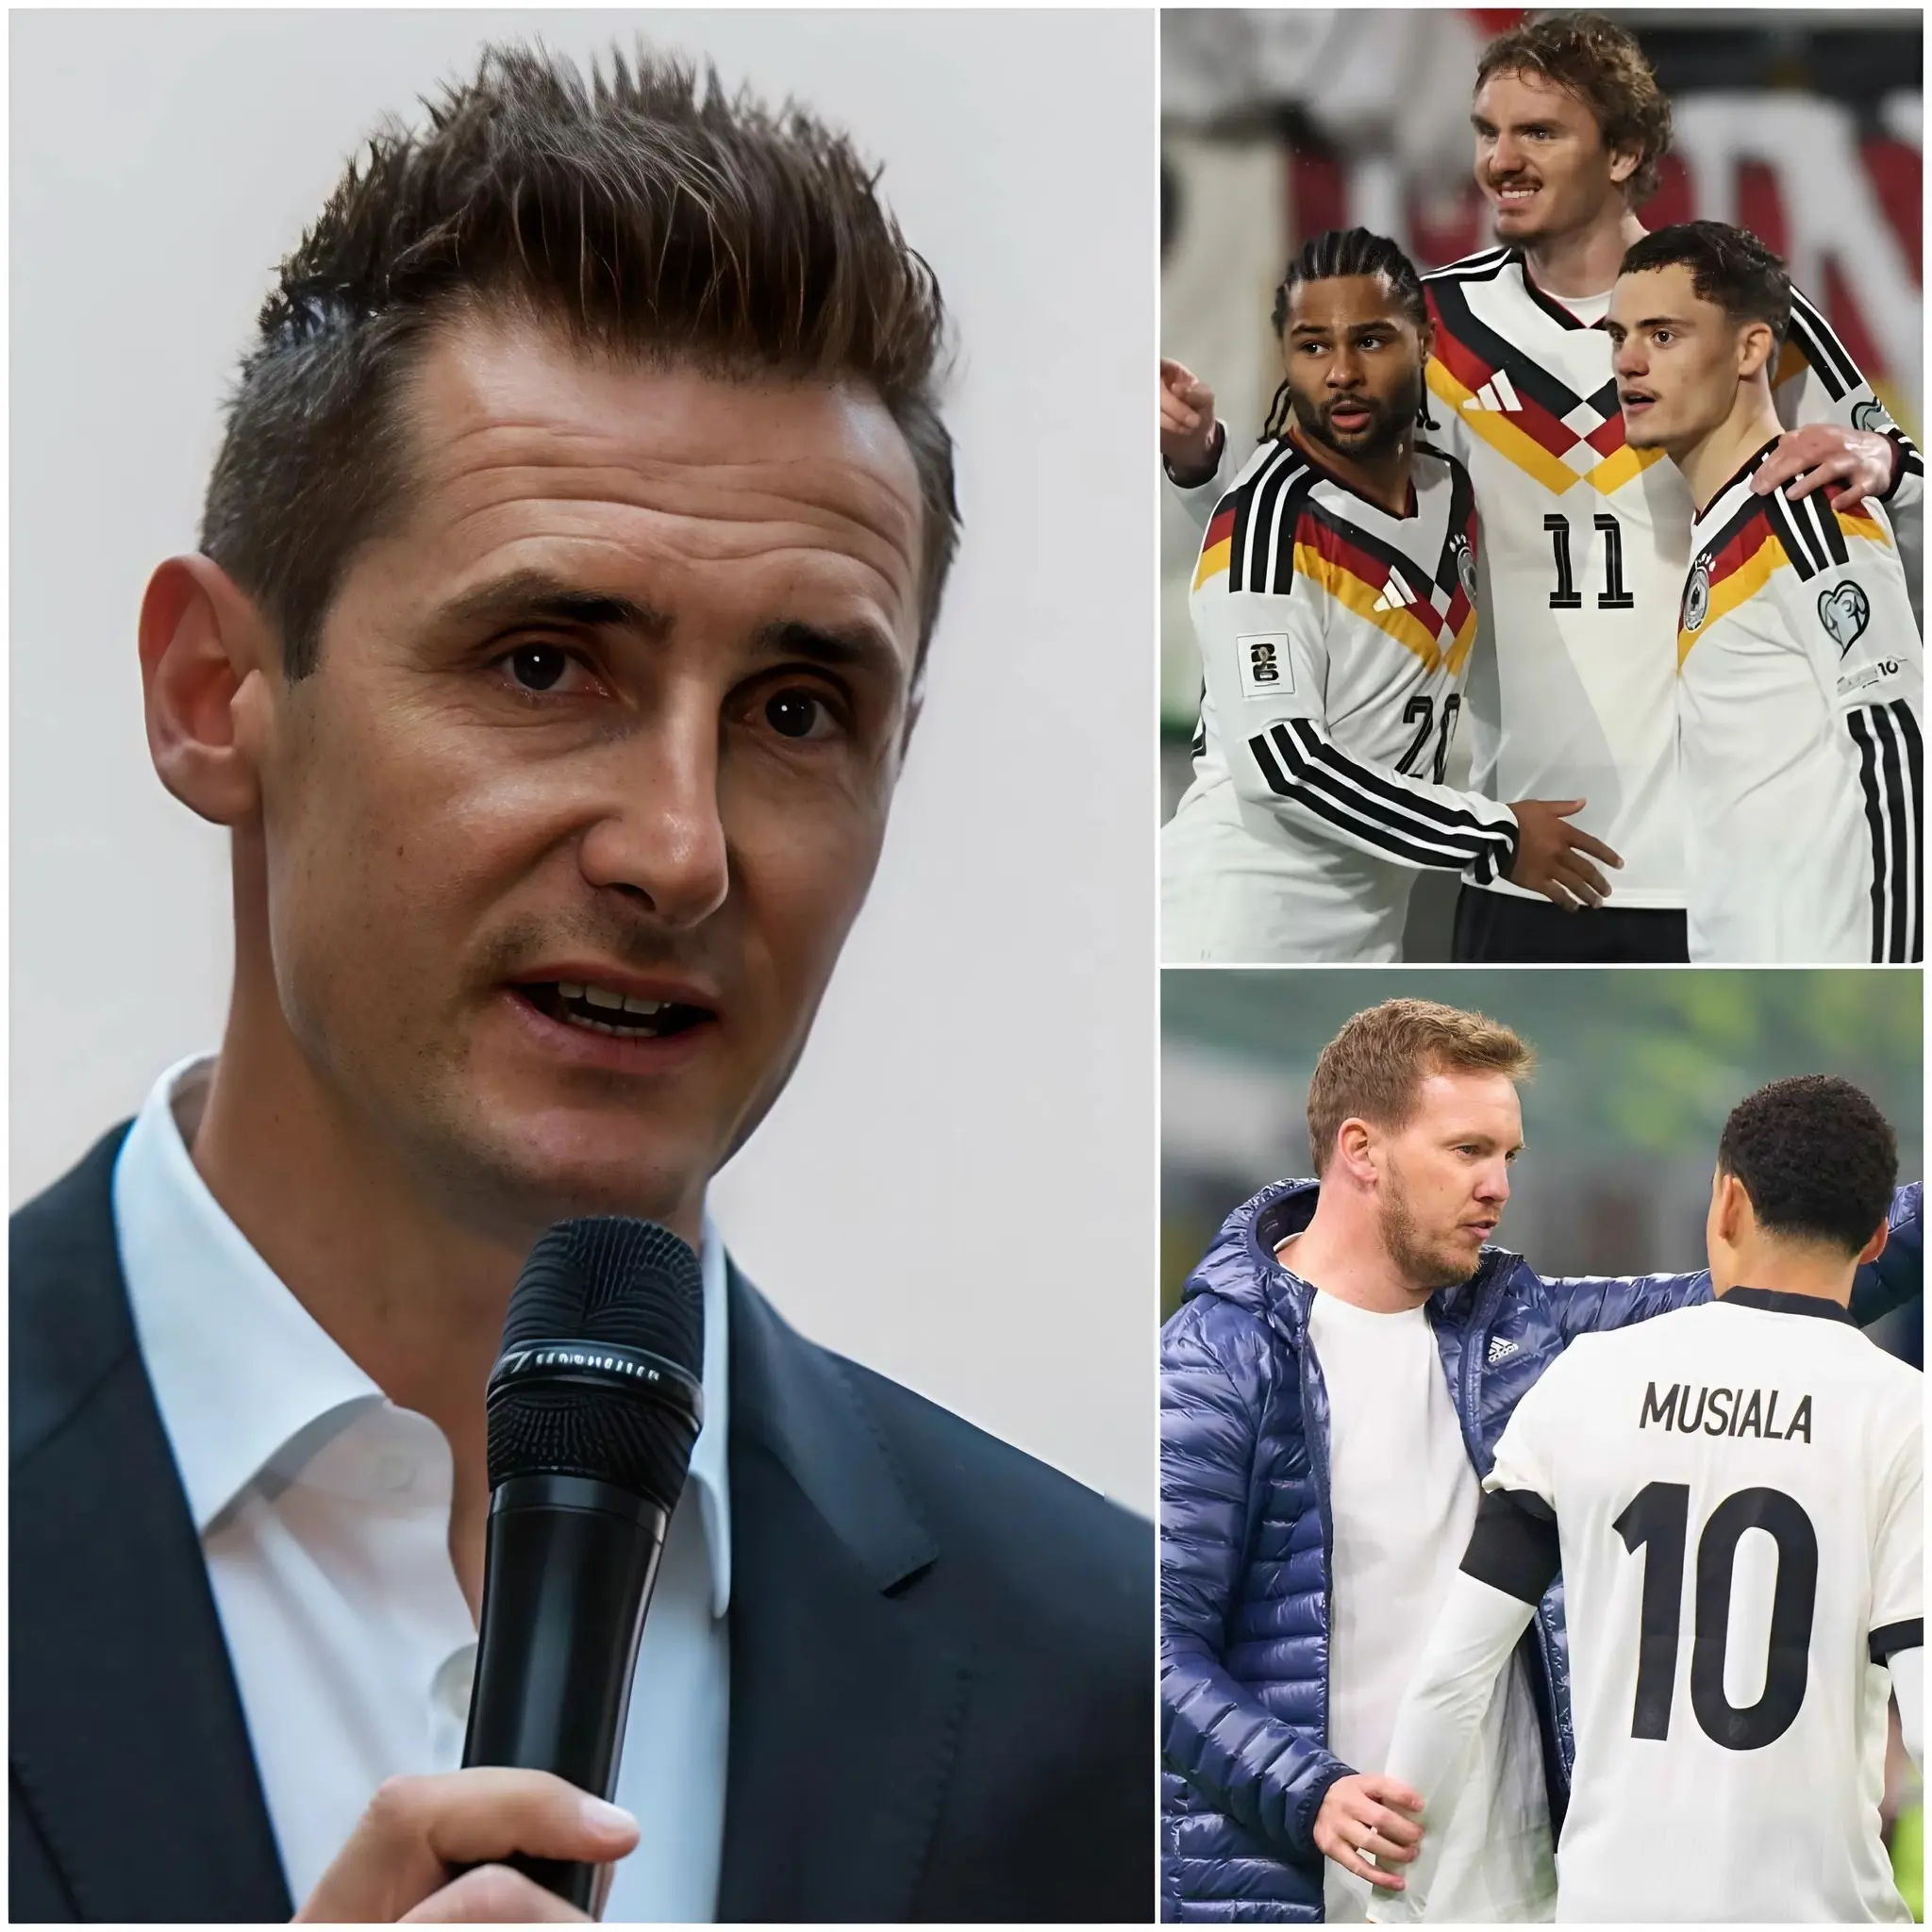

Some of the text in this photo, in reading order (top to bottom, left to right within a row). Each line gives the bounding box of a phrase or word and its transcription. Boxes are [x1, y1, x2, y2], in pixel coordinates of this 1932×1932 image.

[1543, 513, 1635, 609] 11
[1393, 693, 1461, 785] 20
[1639, 1381, 1812, 1444] MUSIALA
[1611, 1481, 1819, 1751] 10
